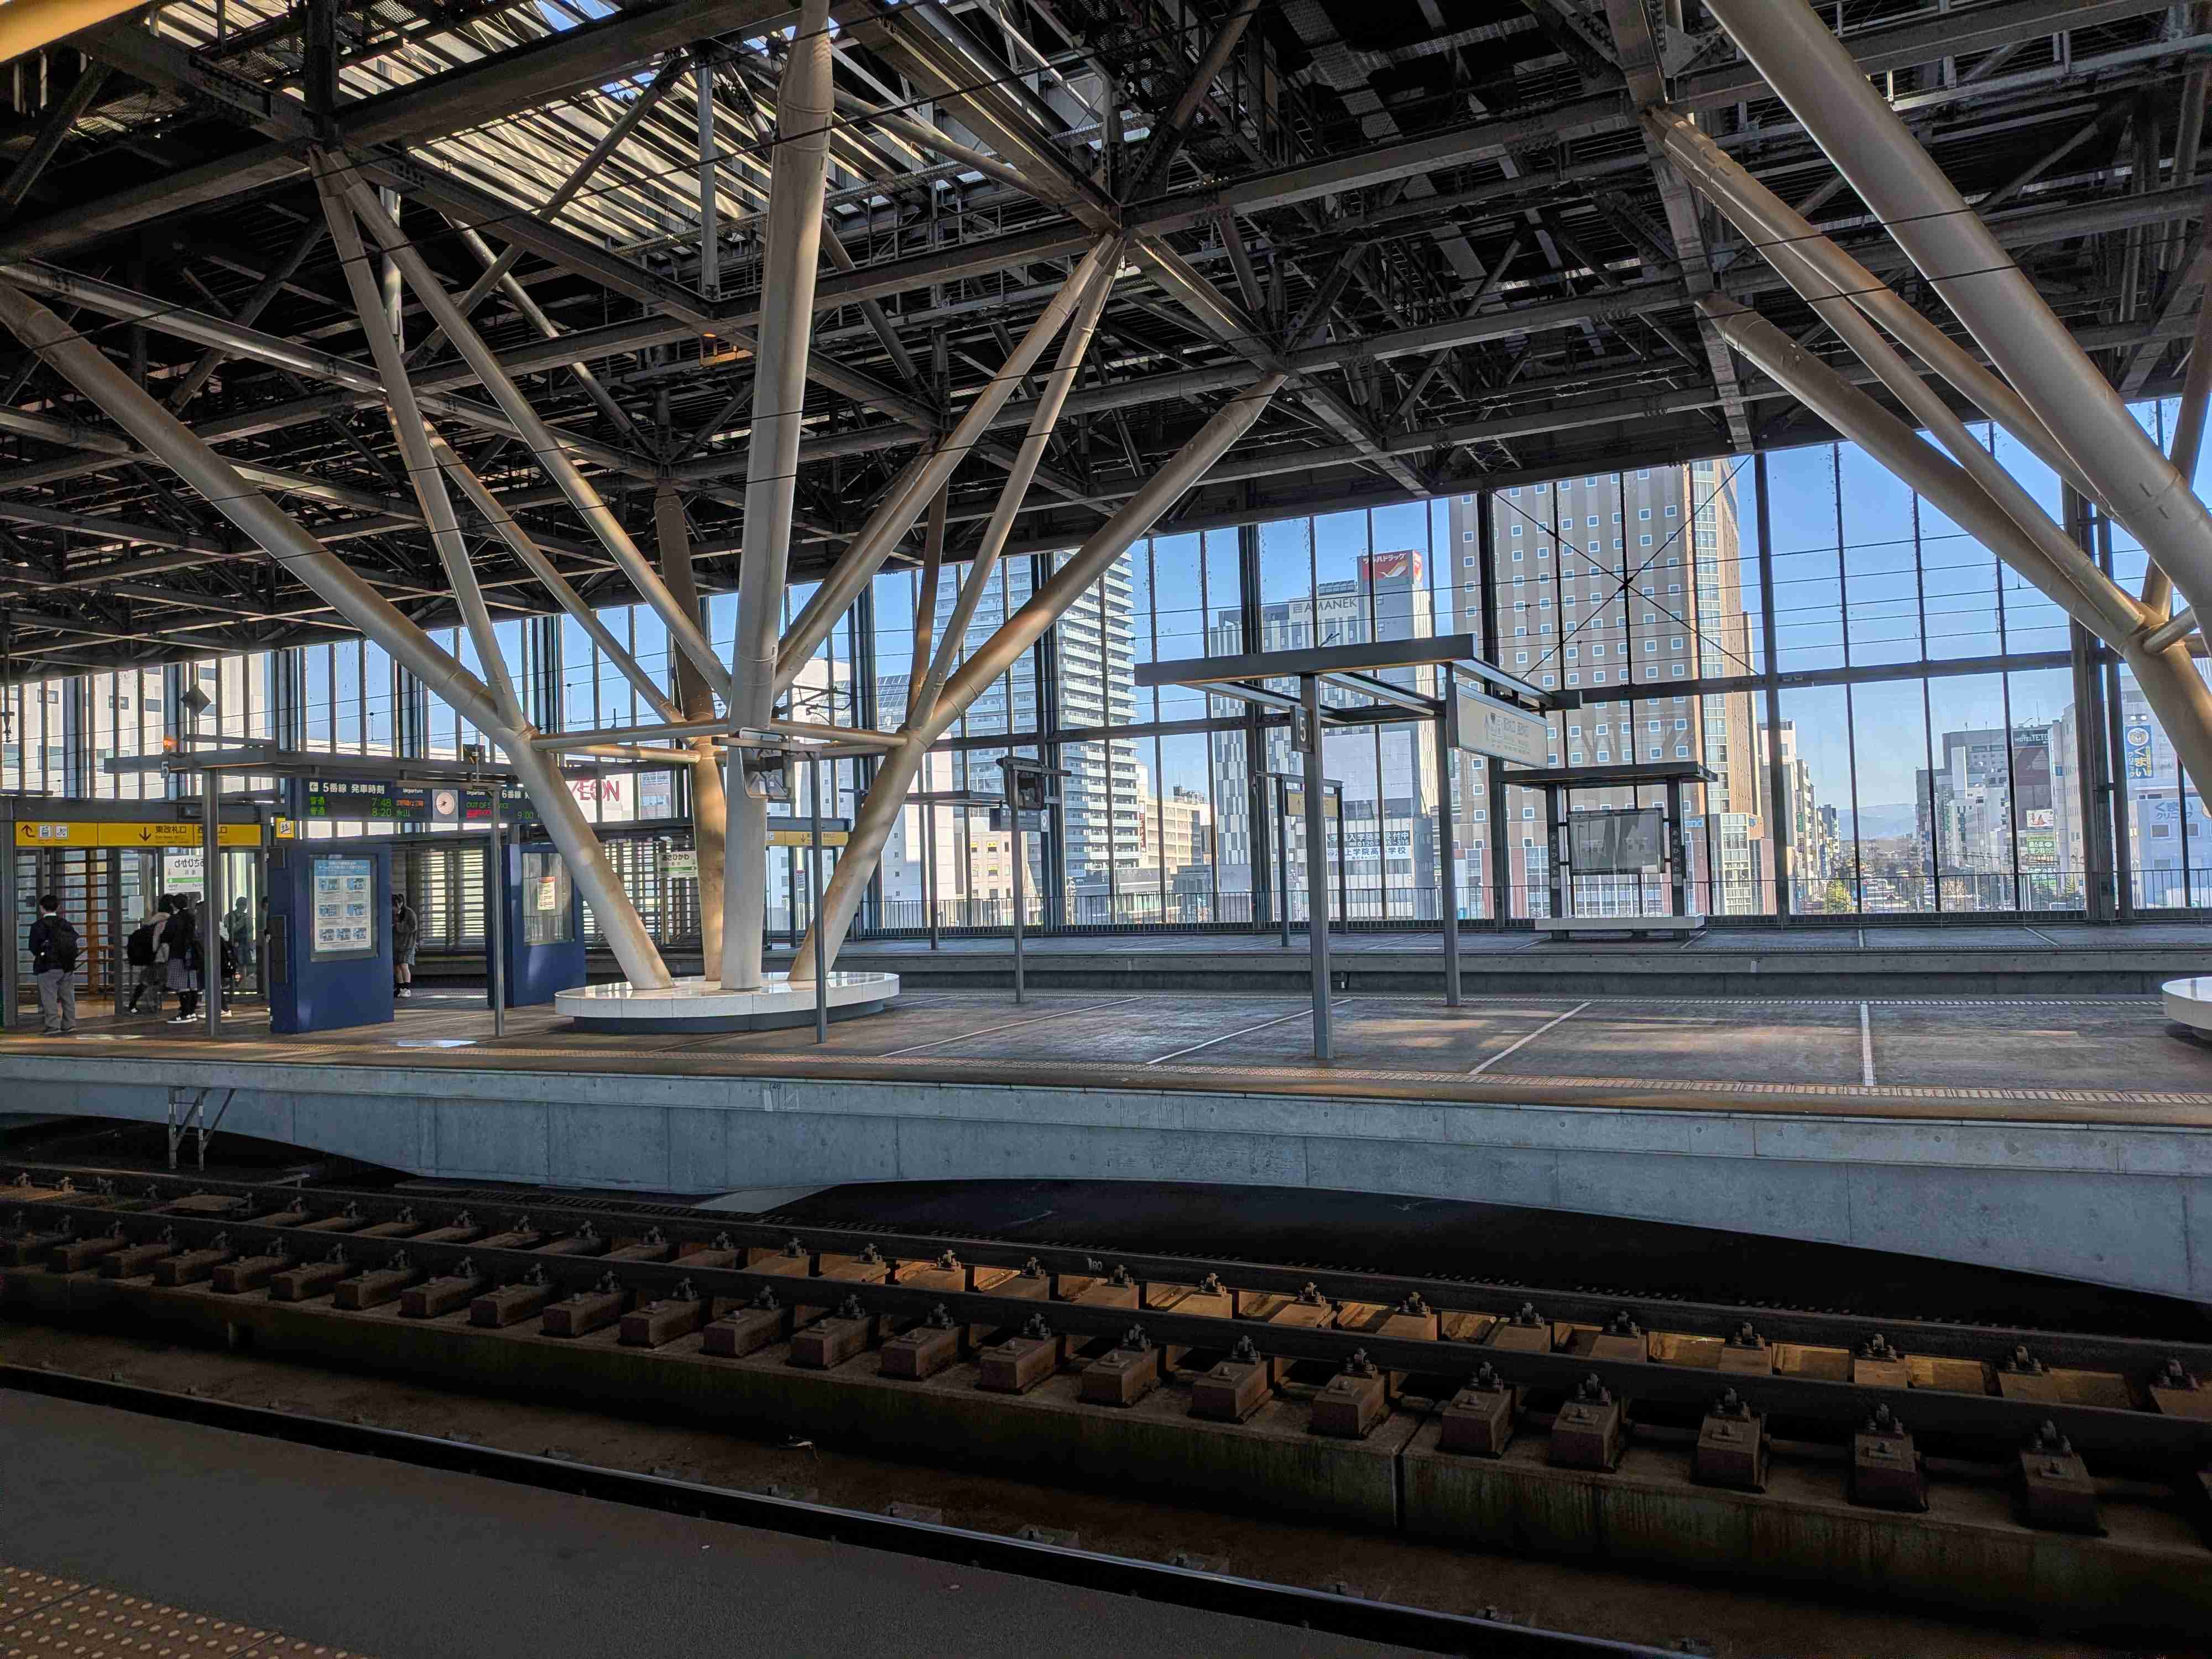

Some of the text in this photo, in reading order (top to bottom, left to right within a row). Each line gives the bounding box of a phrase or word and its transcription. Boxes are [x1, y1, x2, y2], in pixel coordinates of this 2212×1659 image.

[1304, 597, 1358, 612] AMANEK
[1299, 717, 1306, 742] 5
[161, 761, 169, 779] 5
[322, 782, 347, 793] 5番線
[371, 808, 392, 817] 8:20
